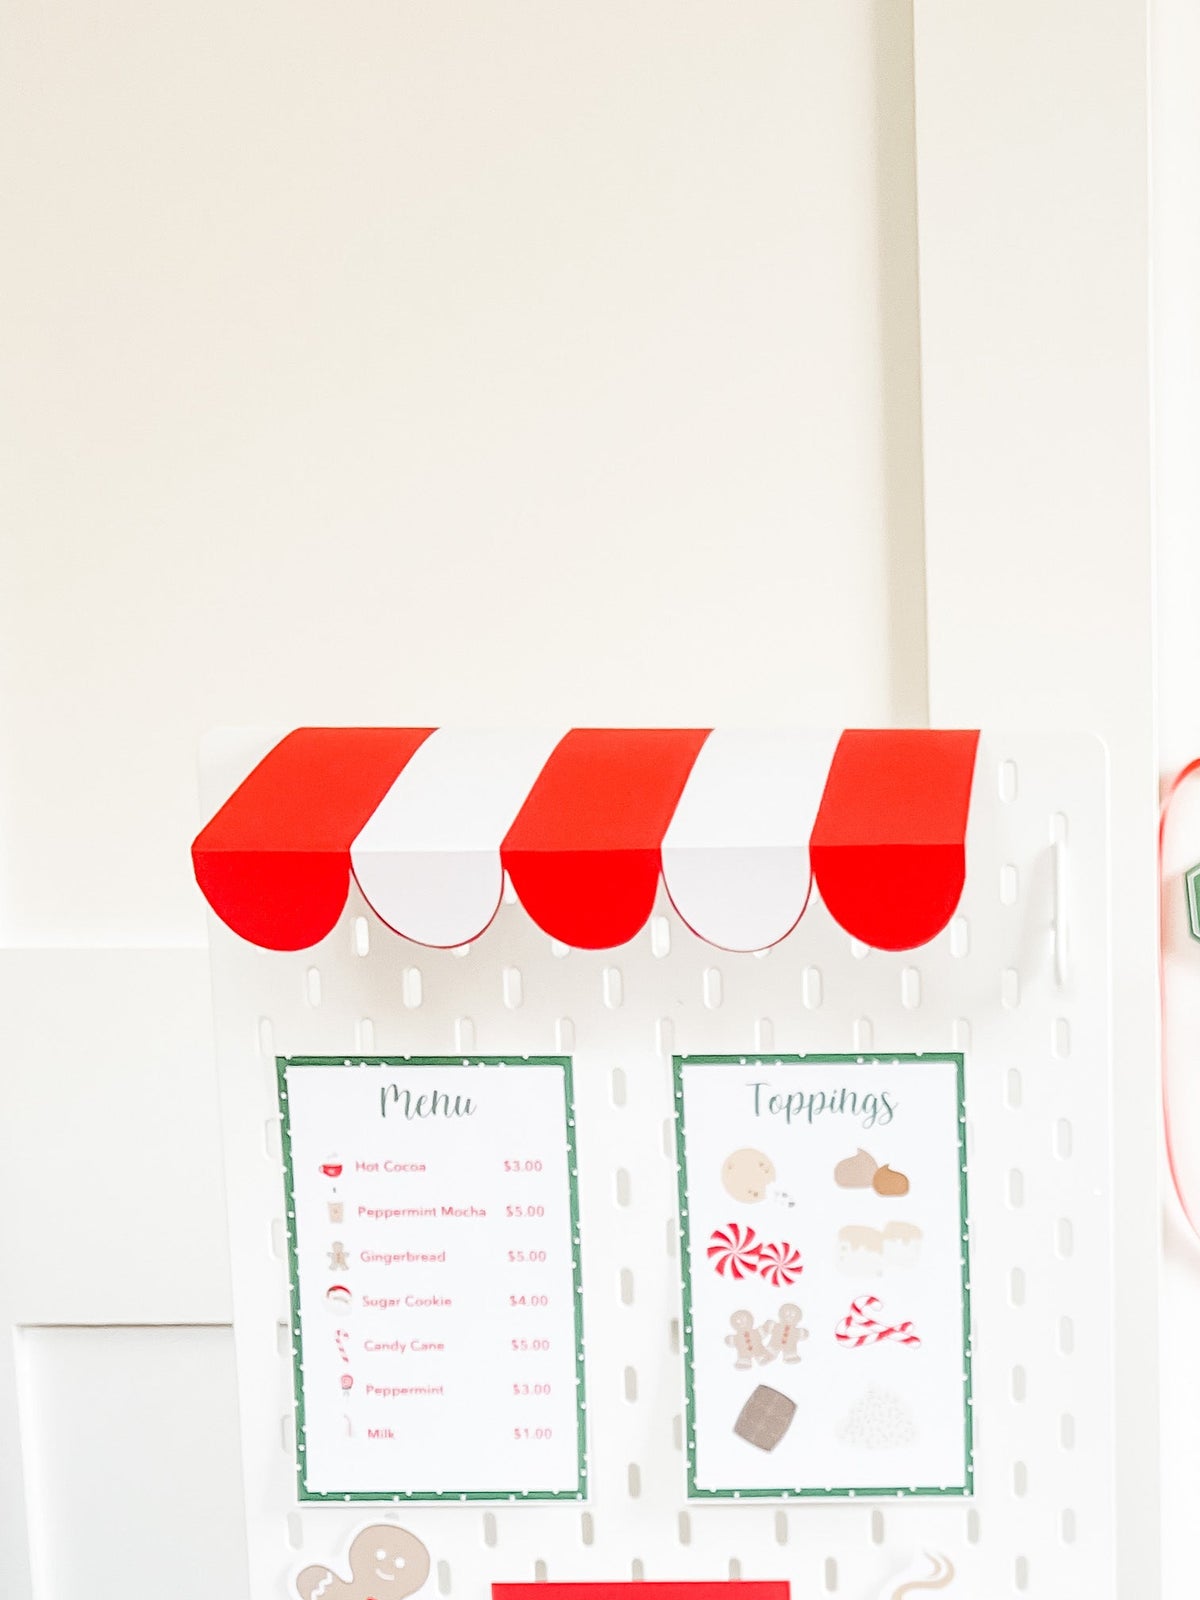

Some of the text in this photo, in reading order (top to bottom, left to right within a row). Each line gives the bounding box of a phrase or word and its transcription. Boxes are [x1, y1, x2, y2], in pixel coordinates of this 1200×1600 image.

[379, 1083, 477, 1120] Menu
[746, 1081, 898, 1129] Toppings
[355, 1159, 542, 1173] Hot Cocoa $3.00
[358, 1204, 545, 1219] Peppermint Mocha $5.00
[360, 1249, 547, 1265] Gingerbread $5.00
[362, 1295, 549, 1310] Sugar Cookie $4.00
[364, 1338, 550, 1354] Candy Cane $5.00
[365, 1383, 552, 1399] Peppermint $3.00
[367, 1427, 552, 1440] Milk $1.00
